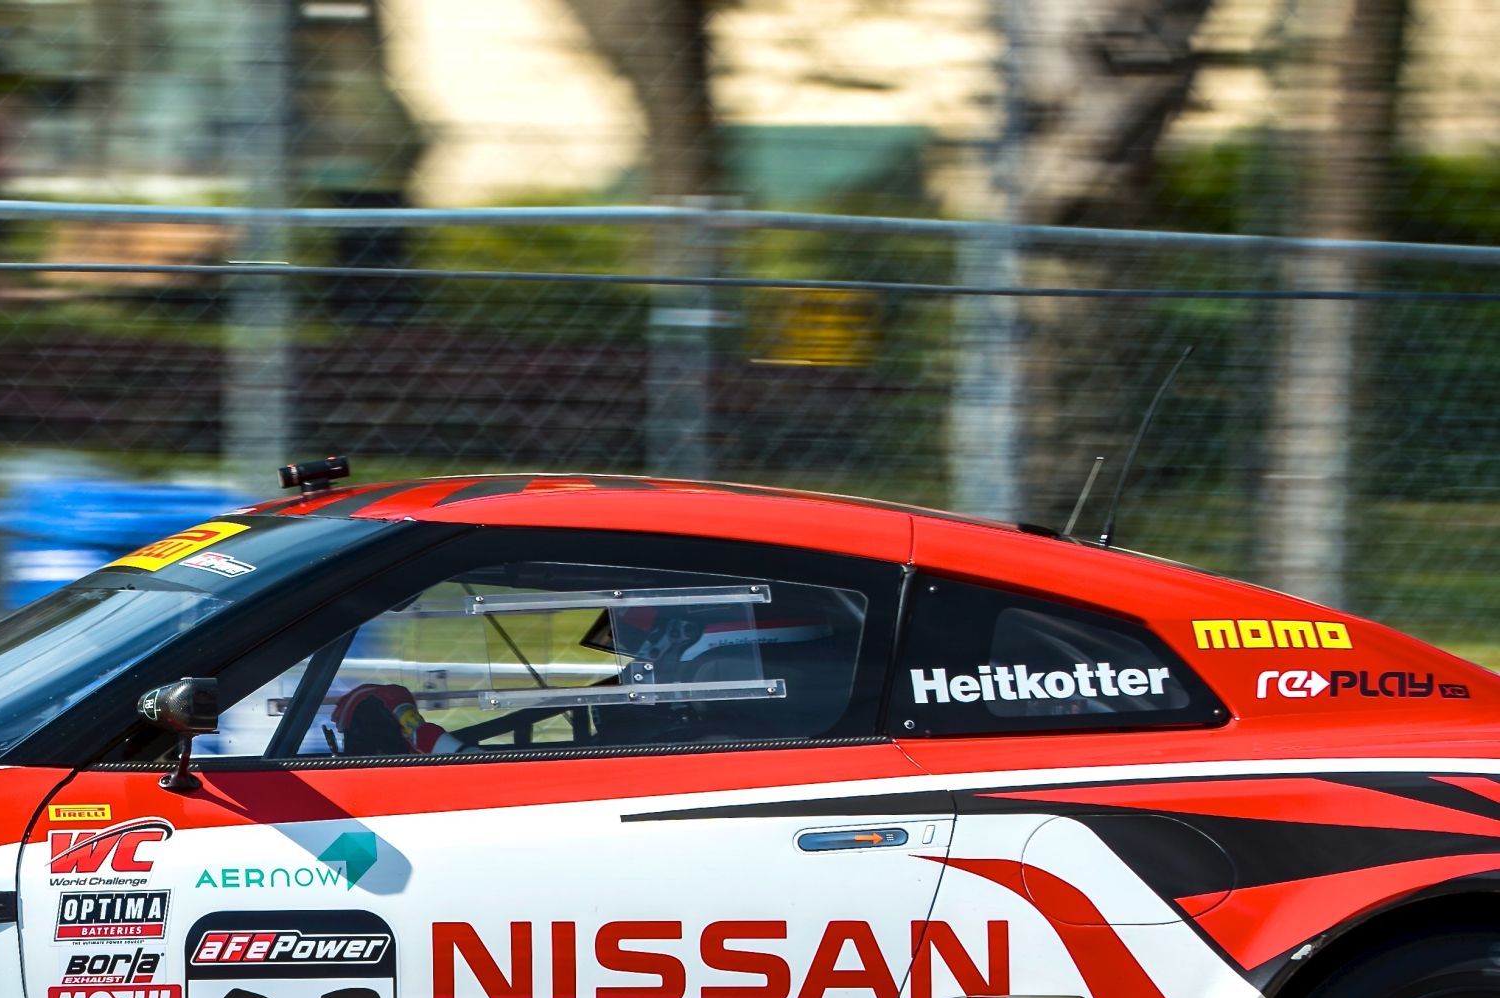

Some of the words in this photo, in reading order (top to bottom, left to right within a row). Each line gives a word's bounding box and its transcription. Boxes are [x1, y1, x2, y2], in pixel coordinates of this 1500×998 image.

[910, 663, 1170, 703] Heitkotter
[55, 808, 106, 817] PIRELLI
[51, 832, 164, 874] WC
[49, 878, 86, 886] World
[89, 877, 148, 887] Challenge
[63, 898, 161, 921] OPTIMA
[81, 926, 142, 936] BATTERIES
[64, 976, 123, 984] EXHAUST
